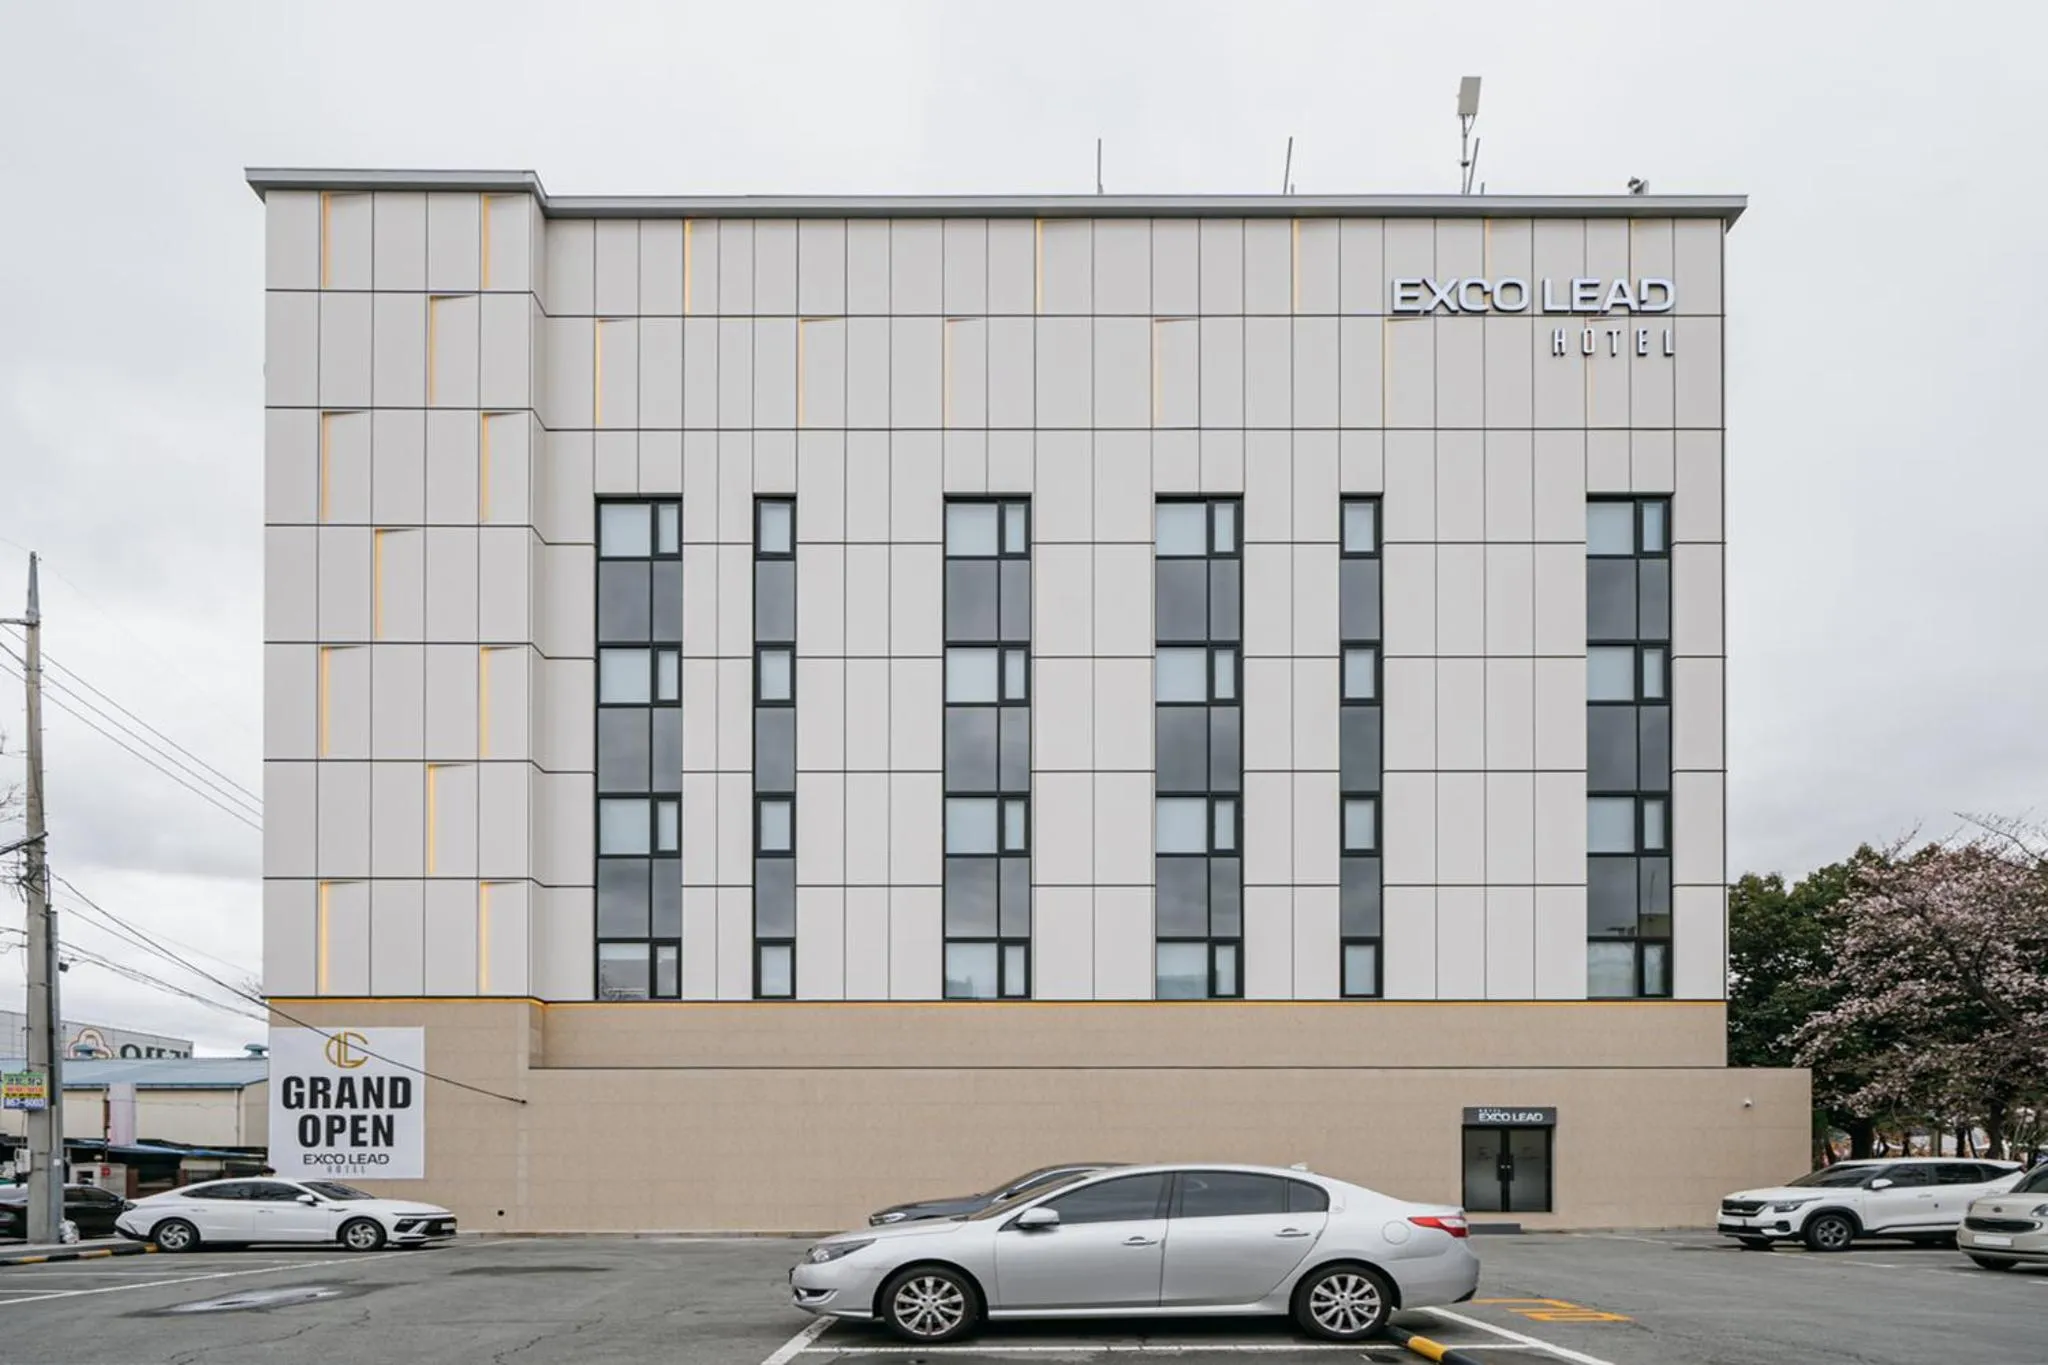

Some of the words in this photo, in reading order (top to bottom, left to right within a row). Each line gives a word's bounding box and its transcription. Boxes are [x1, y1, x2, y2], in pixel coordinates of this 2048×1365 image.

[1392, 278, 1530, 314] EXCO
[1541, 278, 1675, 314] LEAD
[1552, 328, 1674, 357] HOTEL
[282, 1076, 411, 1110] GRAND
[298, 1114, 394, 1148] OPEN
[1478, 1112, 1511, 1122] EXCO
[1512, 1112, 1544, 1122] LEAD
[303, 1153, 346, 1165] EXCO
[348, 1153, 390, 1165] LEAD
